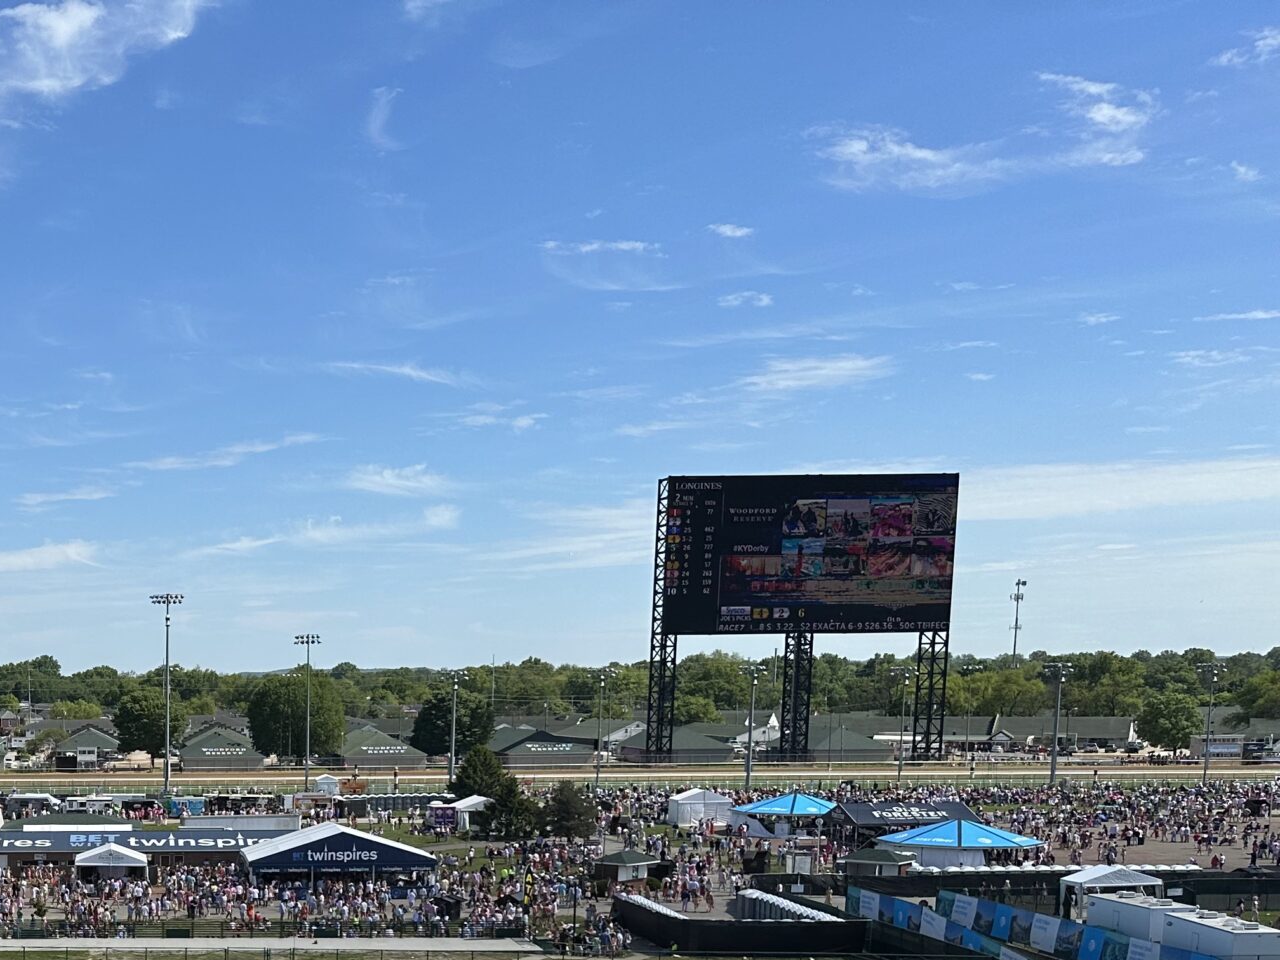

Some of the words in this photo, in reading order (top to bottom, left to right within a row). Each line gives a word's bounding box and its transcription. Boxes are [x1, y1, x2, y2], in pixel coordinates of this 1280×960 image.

[675, 482, 722, 490] LONGINES
[733, 544, 769, 553] #KYDerby
[778, 609, 784, 618] 2
[798, 608, 805, 617] 6
[308, 843, 377, 862] twinspires
